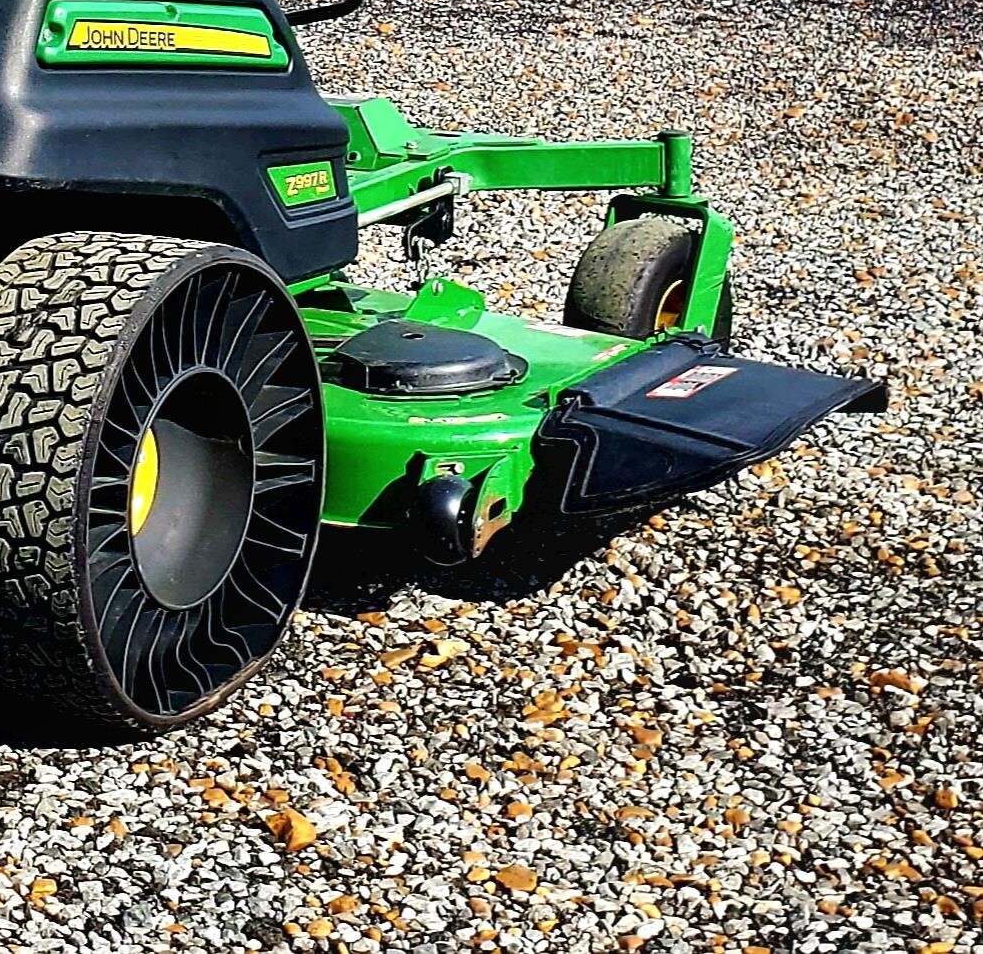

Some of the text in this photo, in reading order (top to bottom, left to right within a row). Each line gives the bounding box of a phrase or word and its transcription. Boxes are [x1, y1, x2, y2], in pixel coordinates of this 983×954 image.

[81, 25, 176, 47] JOHN DEERE
[285, 170, 328, 196] Z997R
